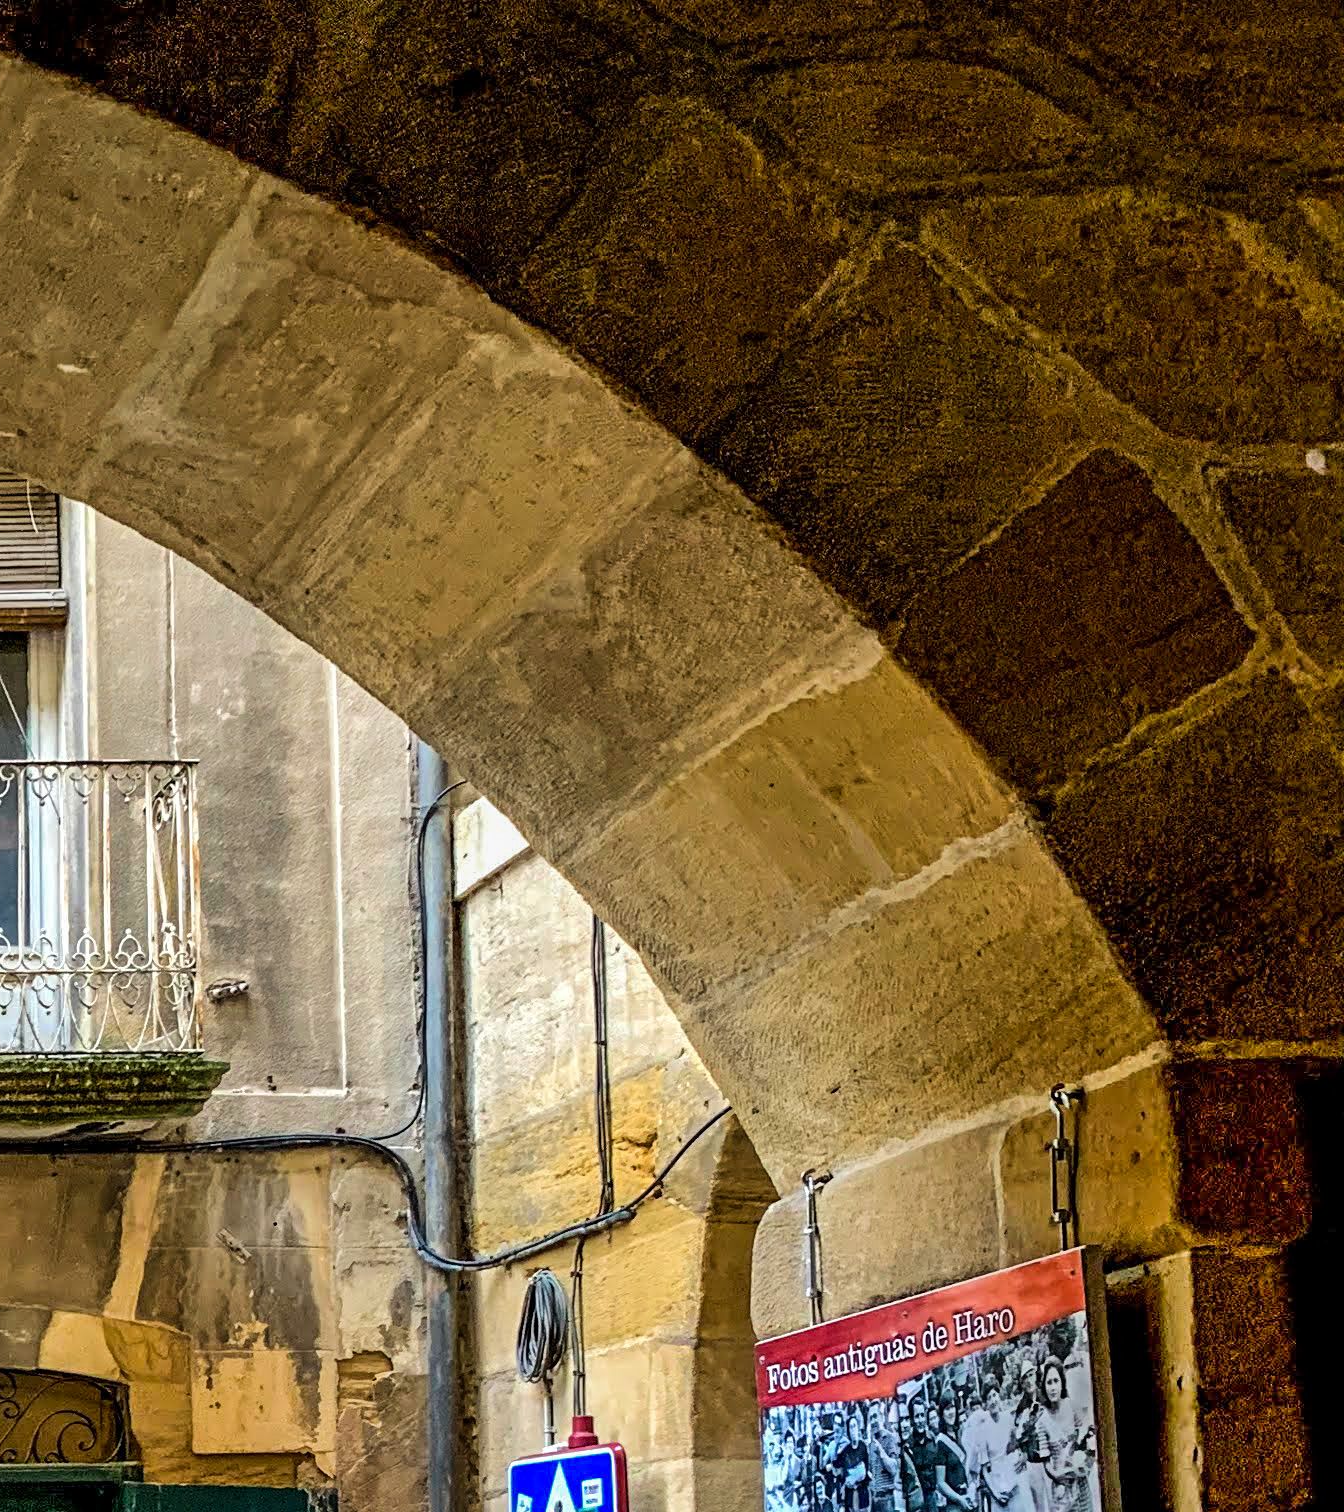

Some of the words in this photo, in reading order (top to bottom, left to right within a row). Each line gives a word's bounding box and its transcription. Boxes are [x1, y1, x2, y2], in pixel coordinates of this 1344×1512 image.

[766, 1359, 819, 1394] Fotos
[823, 1334, 916, 1378] antiguas
[922, 1321, 949, 1354] de
[952, 1307, 1015, 1345] Haro
